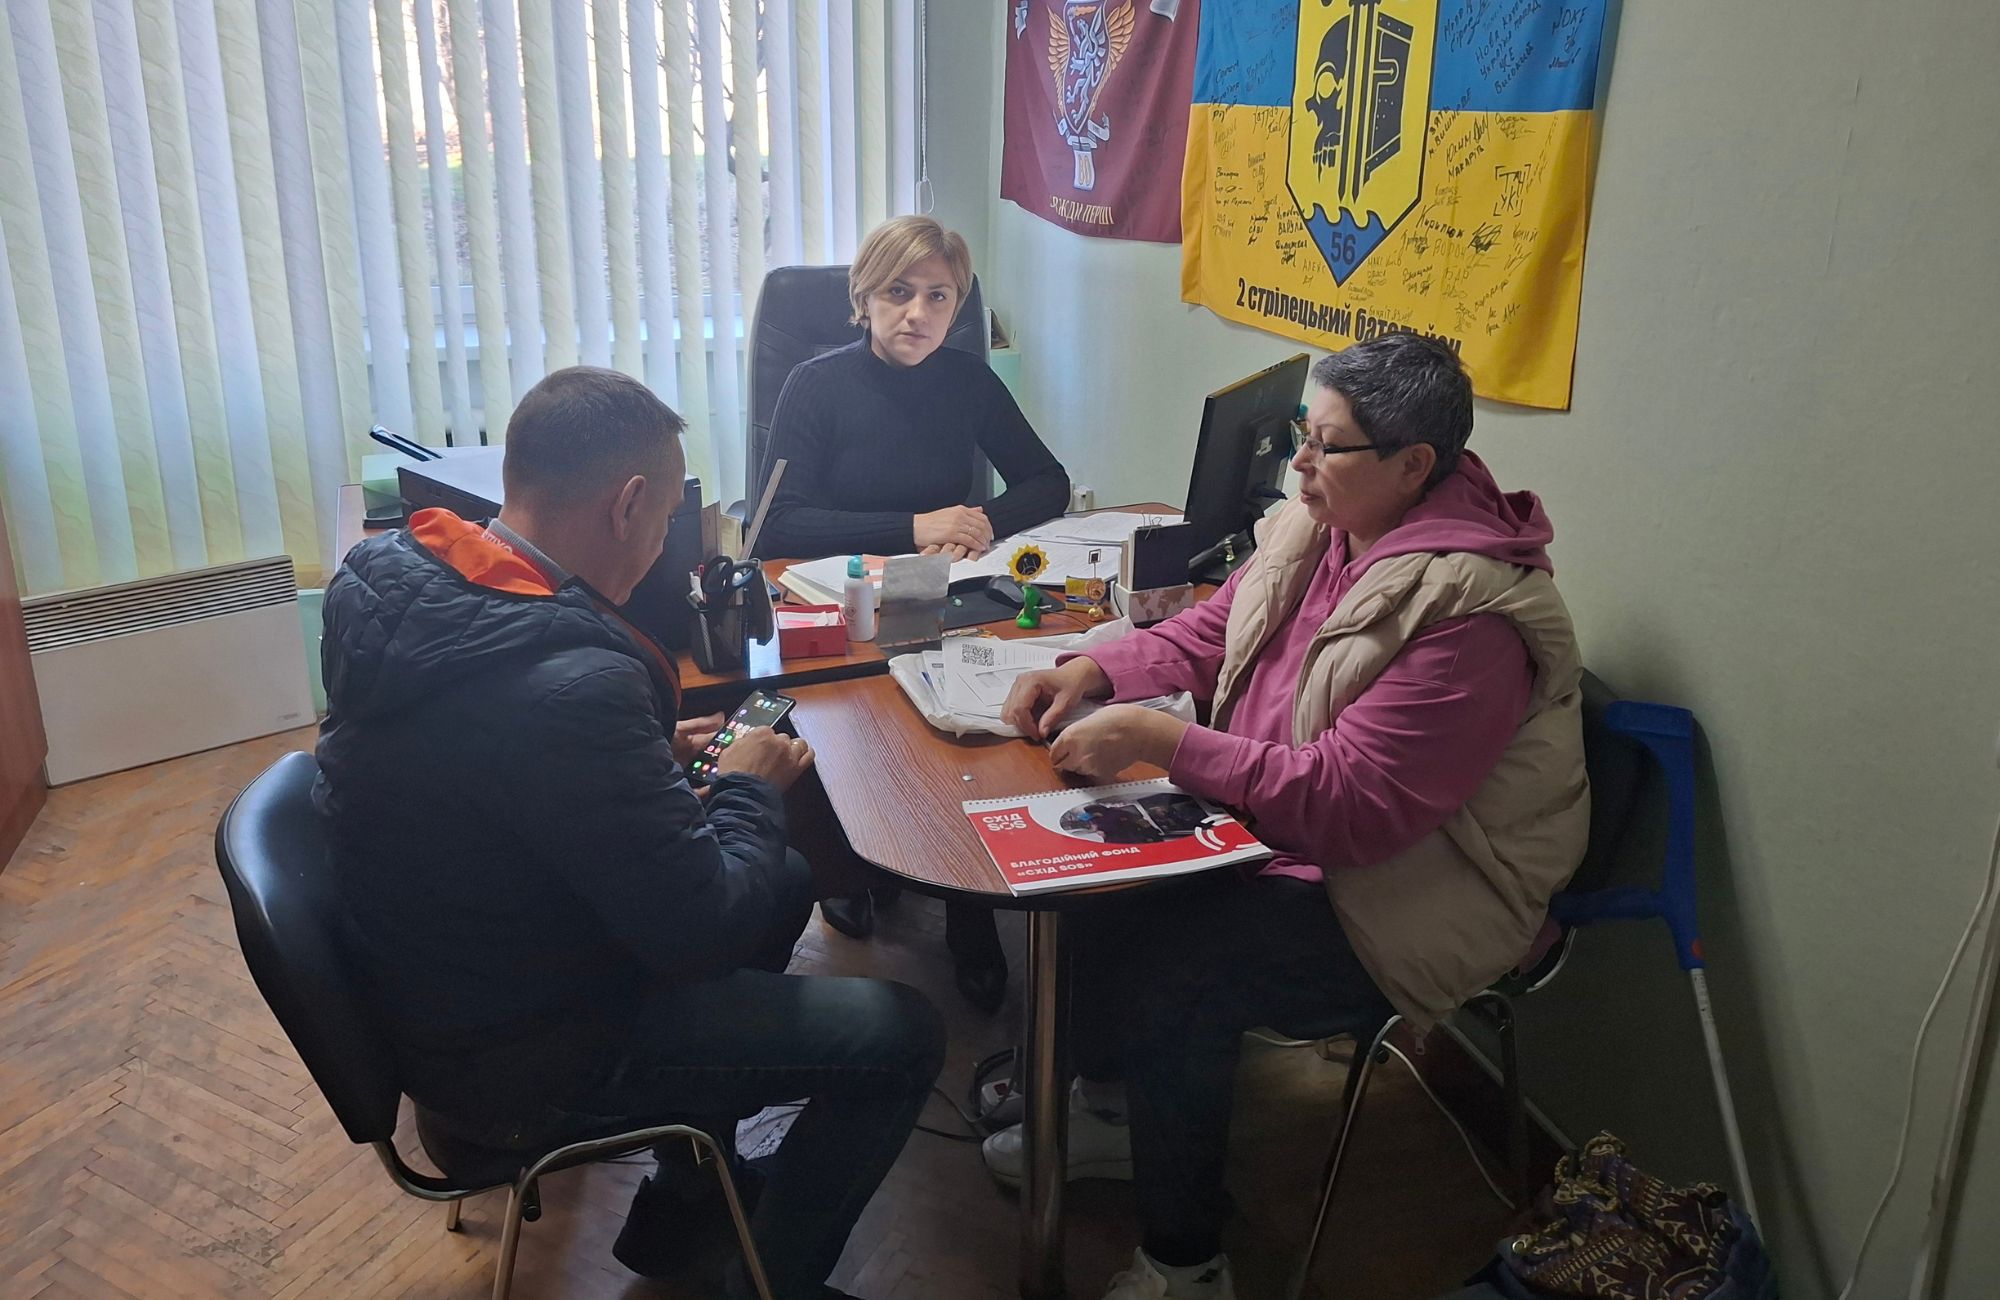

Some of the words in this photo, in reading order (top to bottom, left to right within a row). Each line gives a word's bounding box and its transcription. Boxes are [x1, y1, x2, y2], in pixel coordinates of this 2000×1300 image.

[1330, 231, 1356, 265] 56
[1236, 277, 1246, 307] 2
[1248, 285, 1351, 338] стрілецький
[982, 813, 1023, 824] СХІД
[987, 820, 1028, 832] SOS
[1010, 851, 1099, 869] БЛАГОДІЙНИЙ
[1101, 846, 1141, 857] ФОНД
[1017, 866, 1057, 877] «СХІД
[1059, 862, 1093, 872] SOS»
